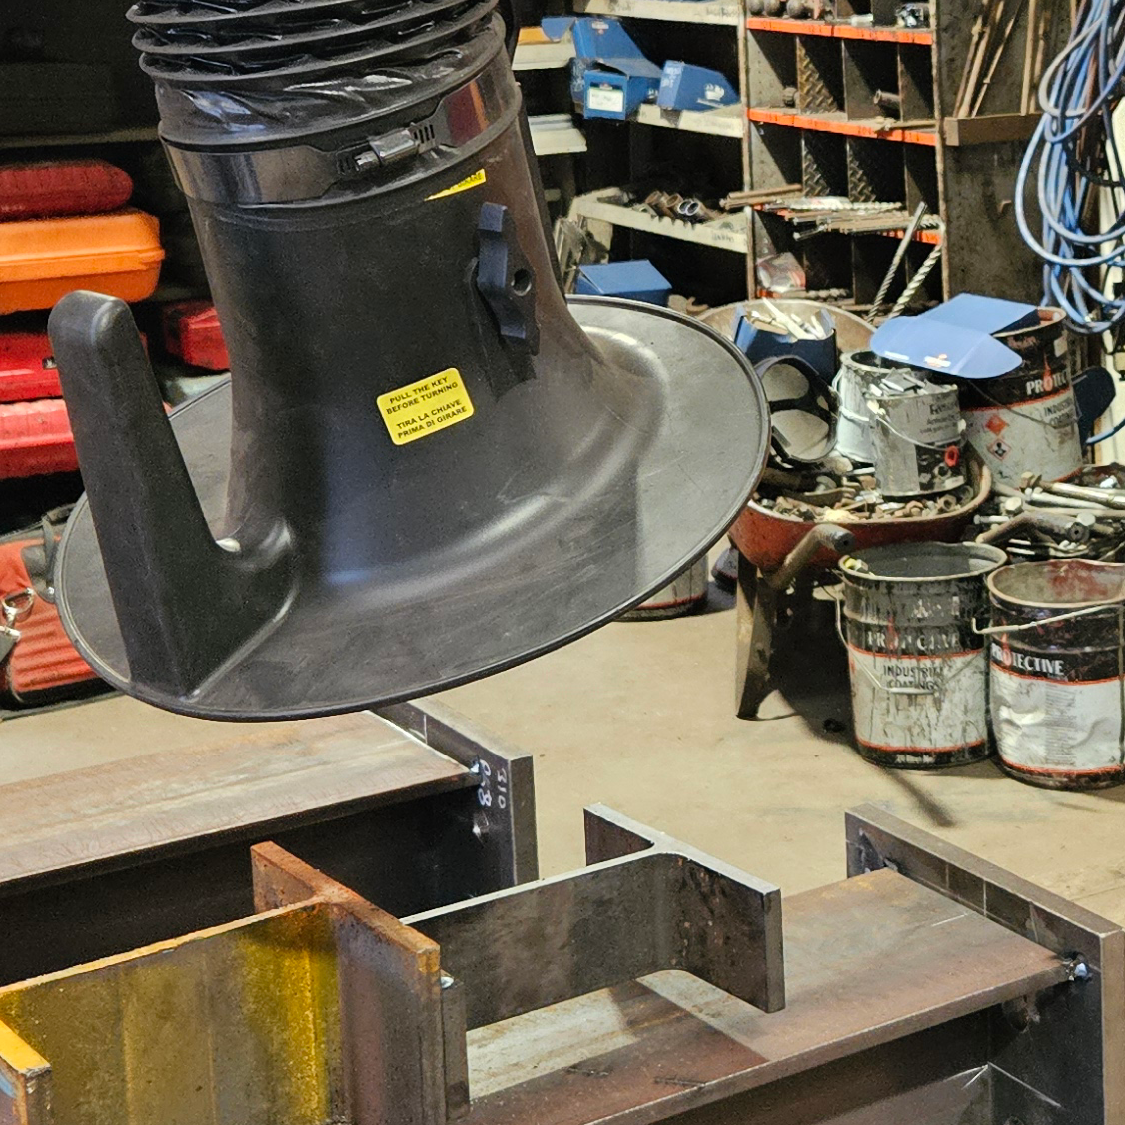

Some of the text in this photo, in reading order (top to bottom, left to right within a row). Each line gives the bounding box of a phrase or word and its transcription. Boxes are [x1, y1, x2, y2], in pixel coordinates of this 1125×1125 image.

[386, 381, 458, 415] BEFORE TURNING
[390, 376, 448, 404] PULL THE KEY
[396, 398, 462, 430] TIRA LA CHIAVE
[397, 405, 468, 439] PRIMA DI GIRARE
